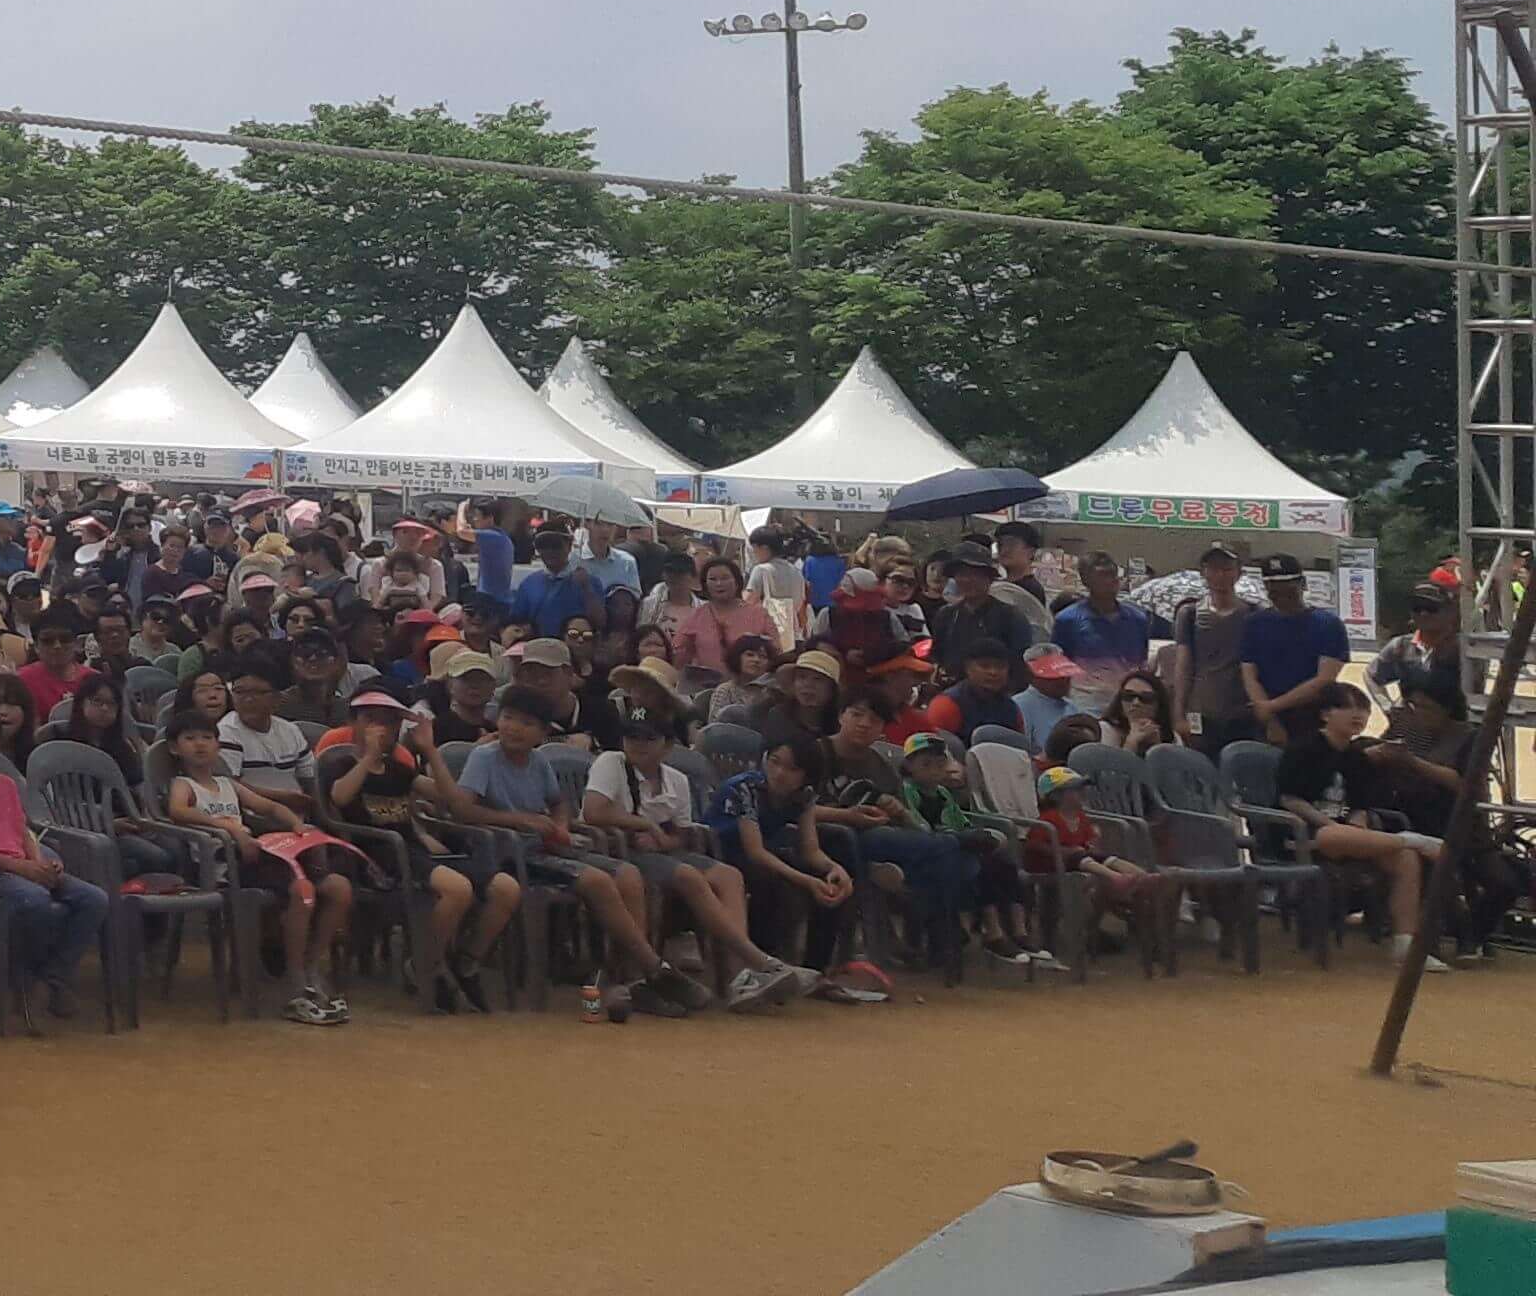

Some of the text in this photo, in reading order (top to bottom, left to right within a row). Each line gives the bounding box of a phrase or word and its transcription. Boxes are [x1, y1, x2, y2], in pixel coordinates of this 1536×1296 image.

[47, 447, 206, 468] 너른고을 굼벵이 협동조합
[366, 460, 425, 478] 만들어보는
[459, 463, 507, 481] 산들나비
[796, 484, 862, 501] 목공놀이
[1087, 496, 1270, 526] 드론무료증정
